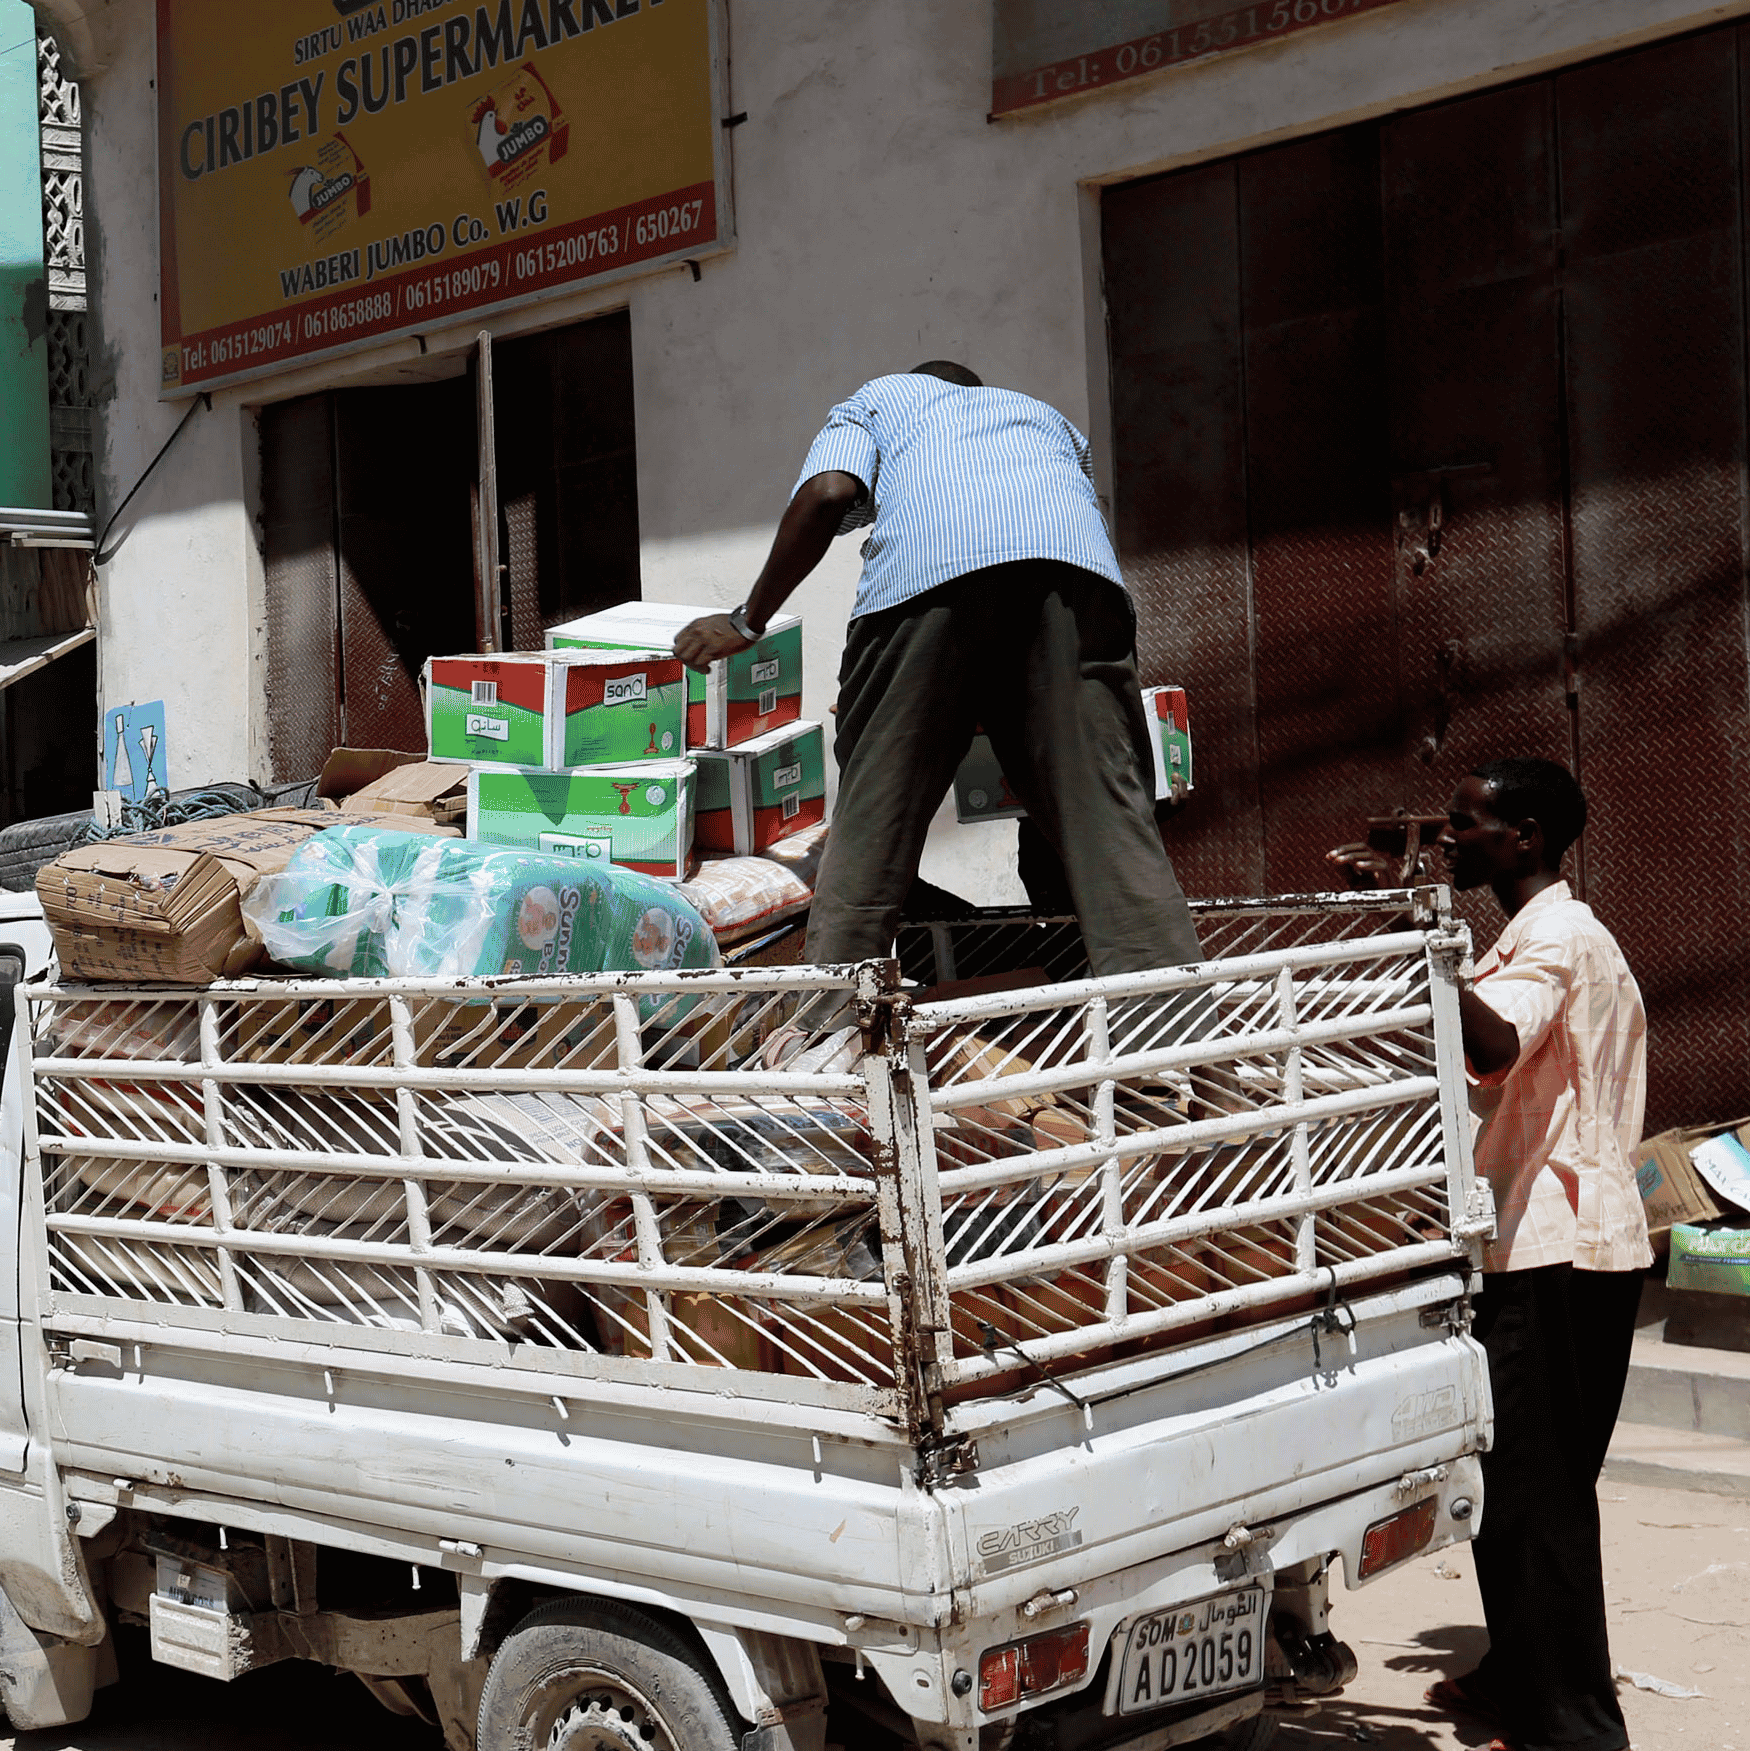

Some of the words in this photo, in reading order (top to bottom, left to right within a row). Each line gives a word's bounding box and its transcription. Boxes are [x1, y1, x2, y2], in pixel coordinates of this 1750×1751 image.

[294, 23, 343, 66] SIRTU
[346, 5, 388, 43] WAA
[1026, 58, 1101, 99] Tel:
[1115, 0, 1360, 74] 06155156
[180, 70, 325, 181] CIRIBEY
[336, 0, 667, 126] SUPERMAR
[501, 121, 544, 160] JUMBO
[316, 176, 350, 206] JUMBO
[279, 247, 361, 299] WABERI
[366, 222, 447, 281] JUMBO
[451, 212, 491, 249] Co.
[494, 189, 548, 234] W.G
[182, 341, 207, 371] Tel:
[210, 320, 292, 365] 0615129074
[304, 291, 392, 339] 0618658888
[405, 259, 500, 310] 0615189079
[515, 225, 619, 280] 0615200763
[635, 199, 703, 245] 650267
[557, 886, 581, 972] Sunn
[976, 1505, 1080, 1557] CARRY
[1008, 1540, 1055, 1565] SUZUKI
[1135, 1615, 1178, 1650] SOM
